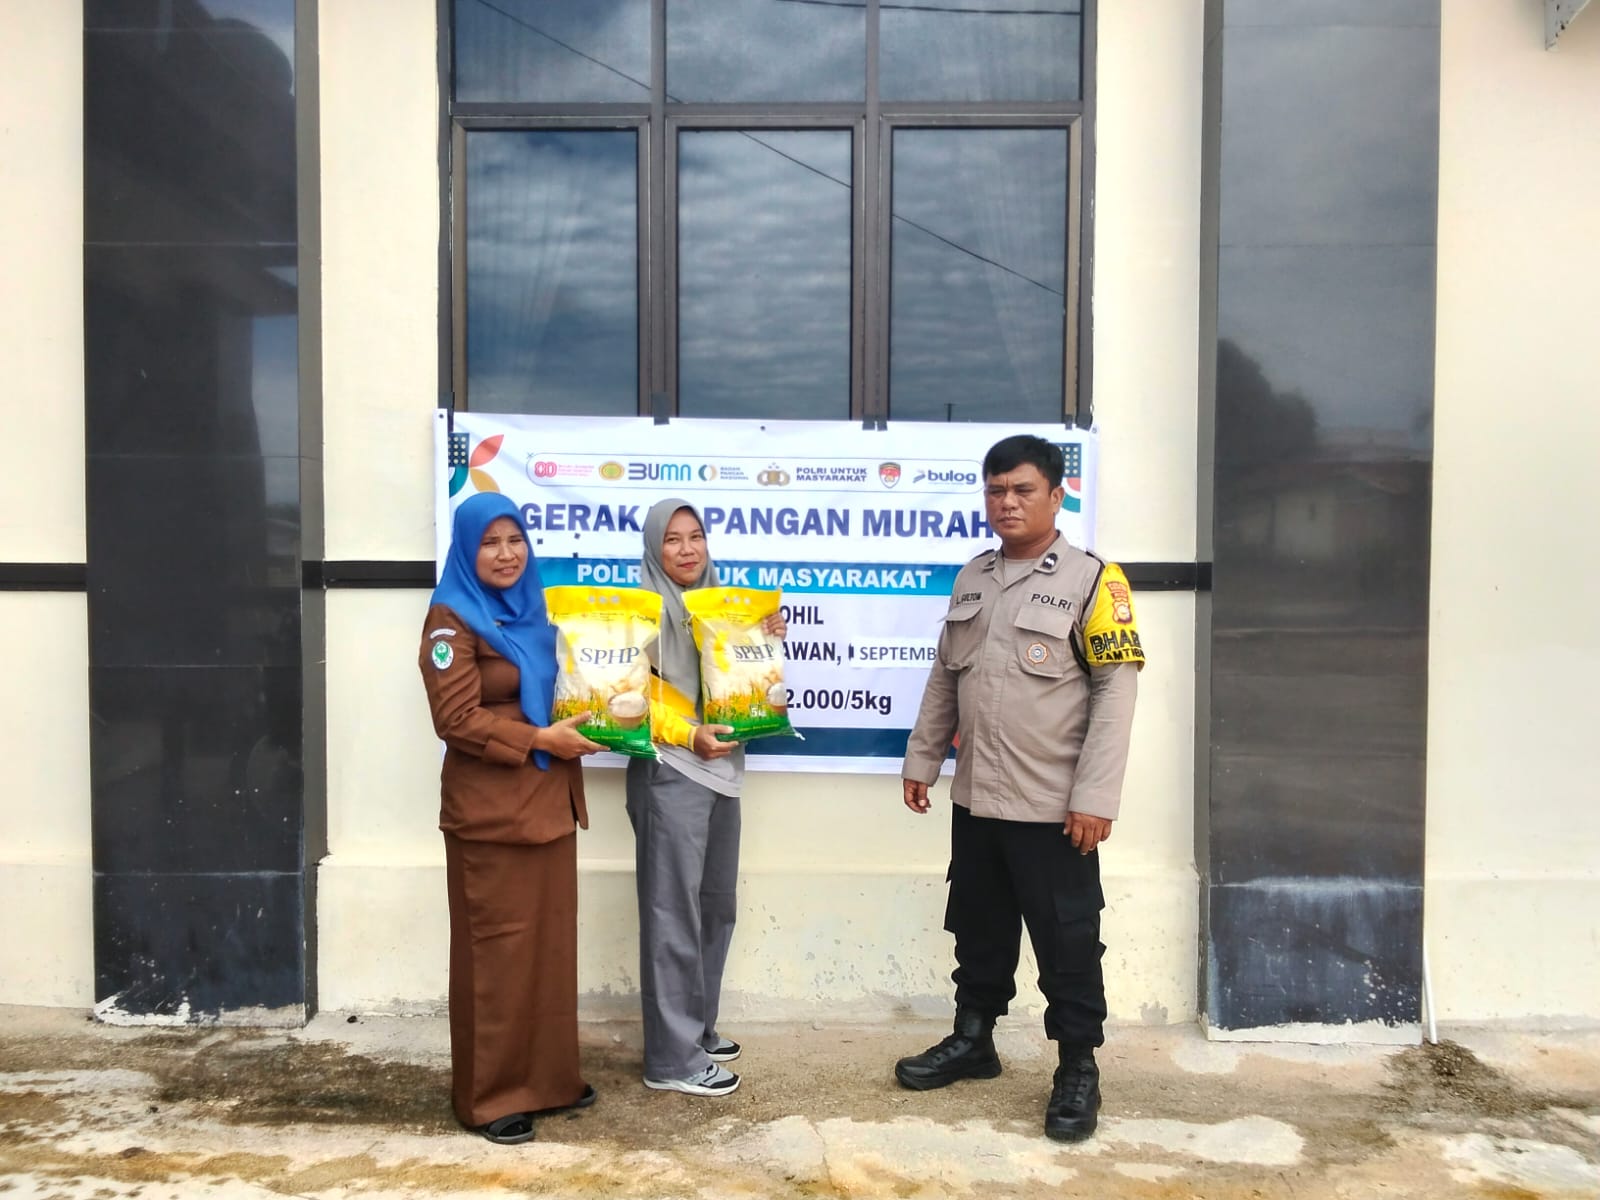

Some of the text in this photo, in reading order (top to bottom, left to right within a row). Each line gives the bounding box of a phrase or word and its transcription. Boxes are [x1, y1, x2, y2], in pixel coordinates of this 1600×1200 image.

[830, 467, 867, 475] UNTUK
[927, 469, 977, 485] bulog
[520, 502, 994, 538] GERAK PANGAN MURAH
[577, 564, 641, 584] POLR
[758, 566, 932, 589] MASYARAKAT
[1030, 593, 1073, 611] POLRI
[779, 605, 825, 625] OHIL
[1089, 628, 1142, 656] BHAB
[580, 646, 641, 665] SPHP
[732, 644, 775, 661] SPHP
[782, 641, 842, 666] AWAN,
[859, 646, 937, 661] SEPTEMB
[786, 688, 892, 716] 2.000/5kg
